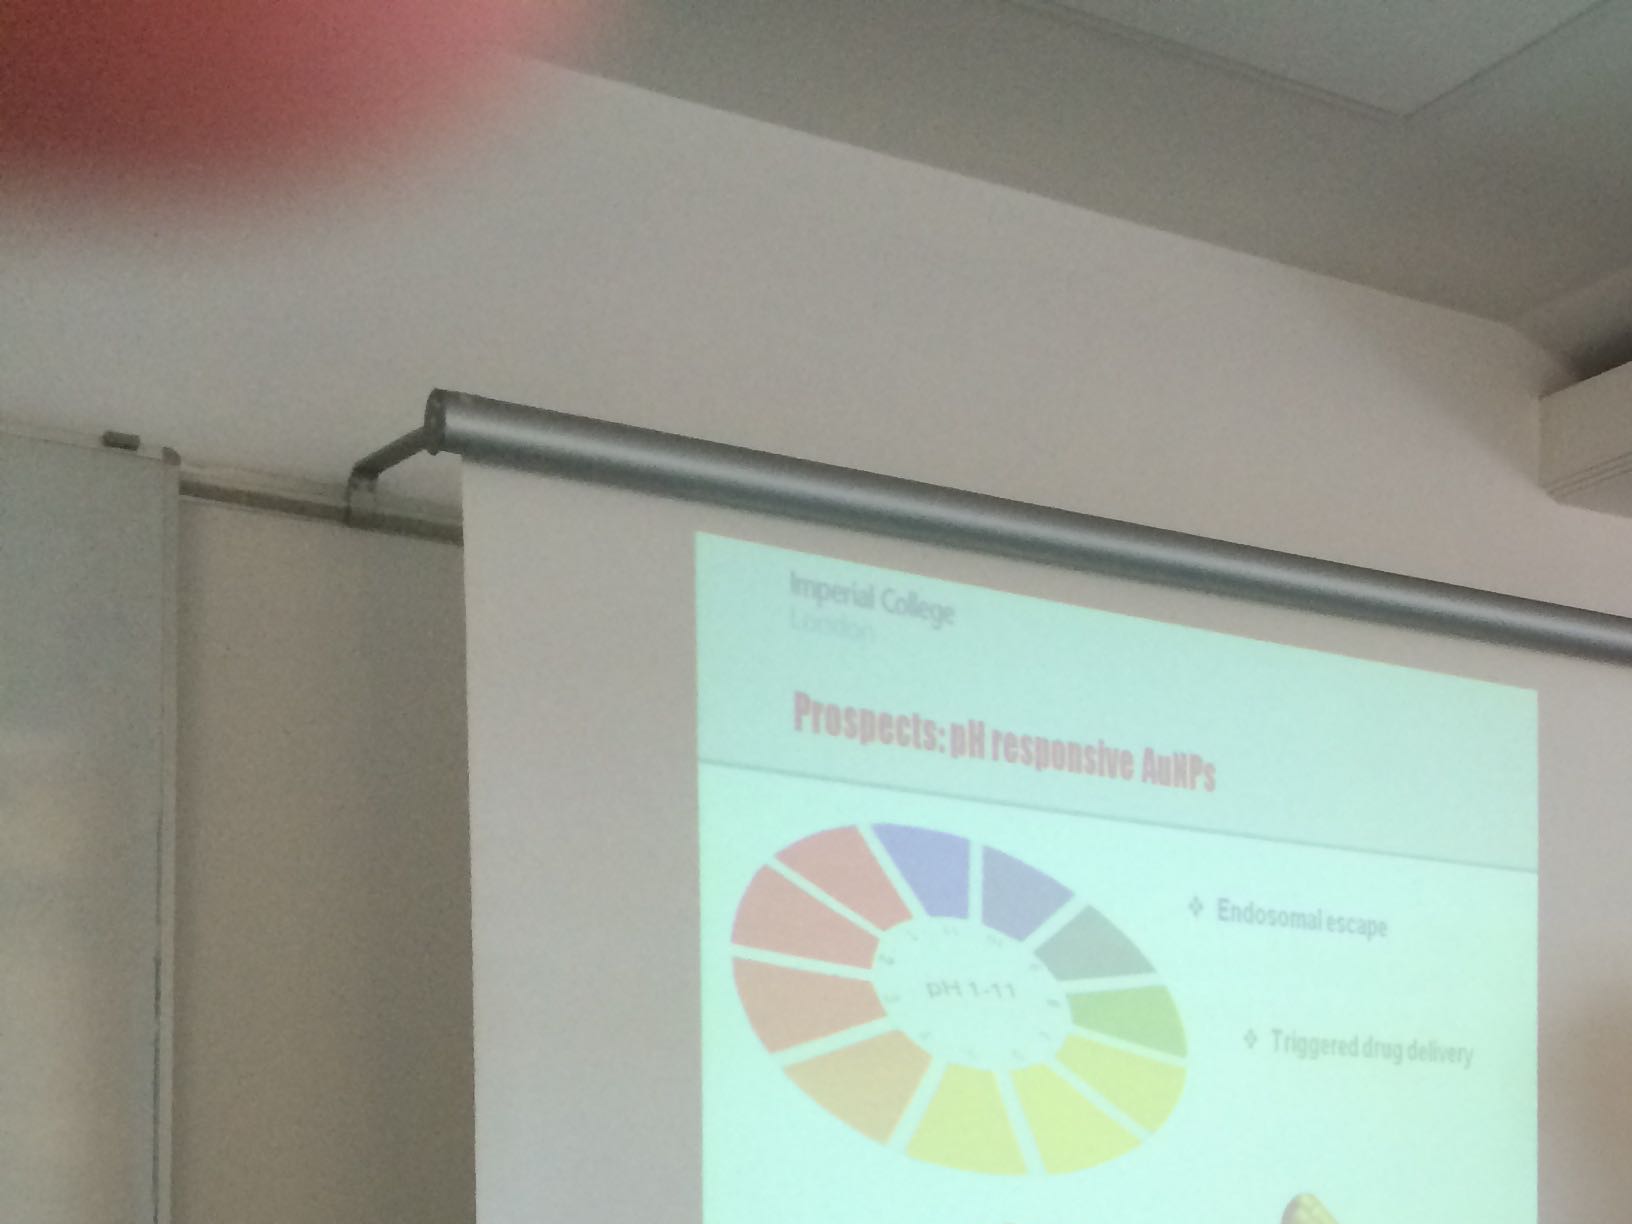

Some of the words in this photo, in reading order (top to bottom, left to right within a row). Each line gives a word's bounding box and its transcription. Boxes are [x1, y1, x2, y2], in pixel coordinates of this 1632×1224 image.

[790, 570, 875, 608] Imperial
[880, 587, 956, 630] College
[793, 691, 946, 754] Prospects:
[949, 718, 986, 760] pH
[990, 727, 1135, 782] responsive
[1139, 746, 1218, 793] AuNPs
[1216, 897, 1324, 932] Endosomal
[1326, 913, 1388, 942] escape
[1271, 1027, 1360, 1061] Triggered
[1362, 1035, 1404, 1066] drug
[1407, 1038, 1475, 1070] delivery
